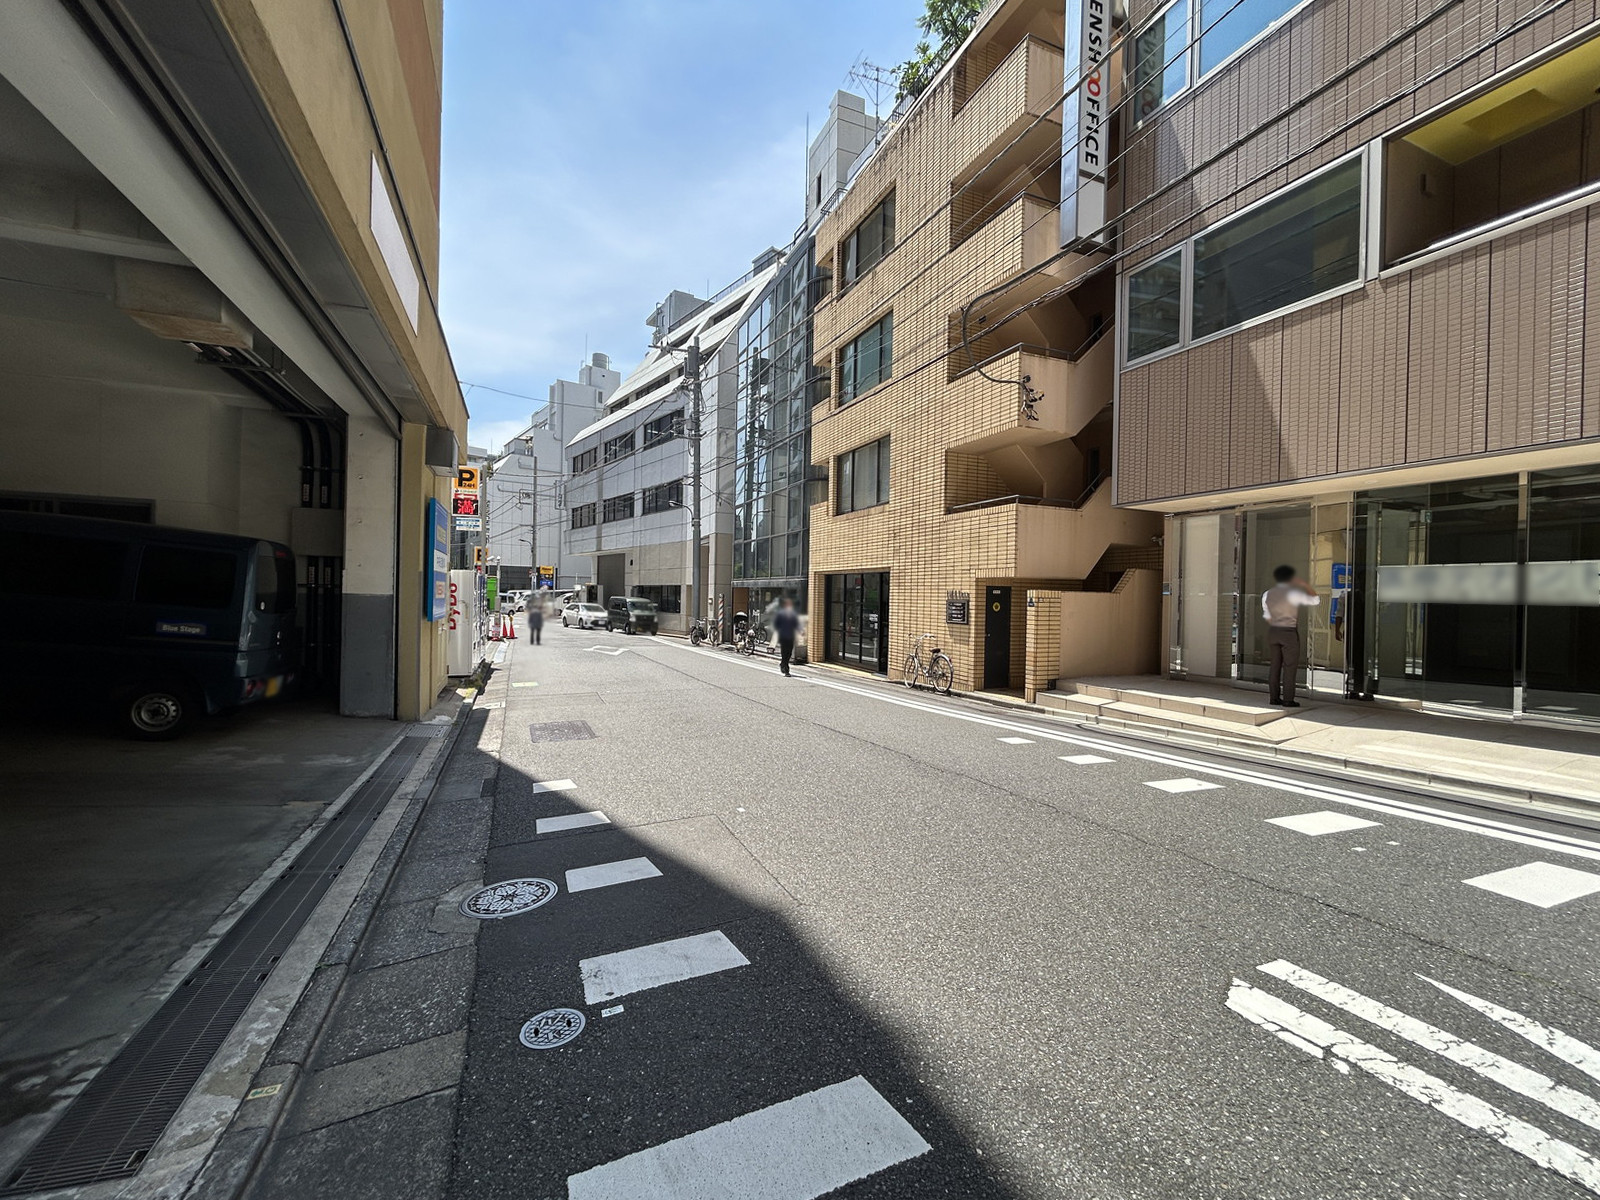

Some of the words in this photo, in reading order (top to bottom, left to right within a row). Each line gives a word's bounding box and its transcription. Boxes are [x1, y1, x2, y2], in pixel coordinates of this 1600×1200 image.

[458, 469, 475, 487] P
[162, 624, 178, 632] Blue
[180, 625, 201, 634] Stage
